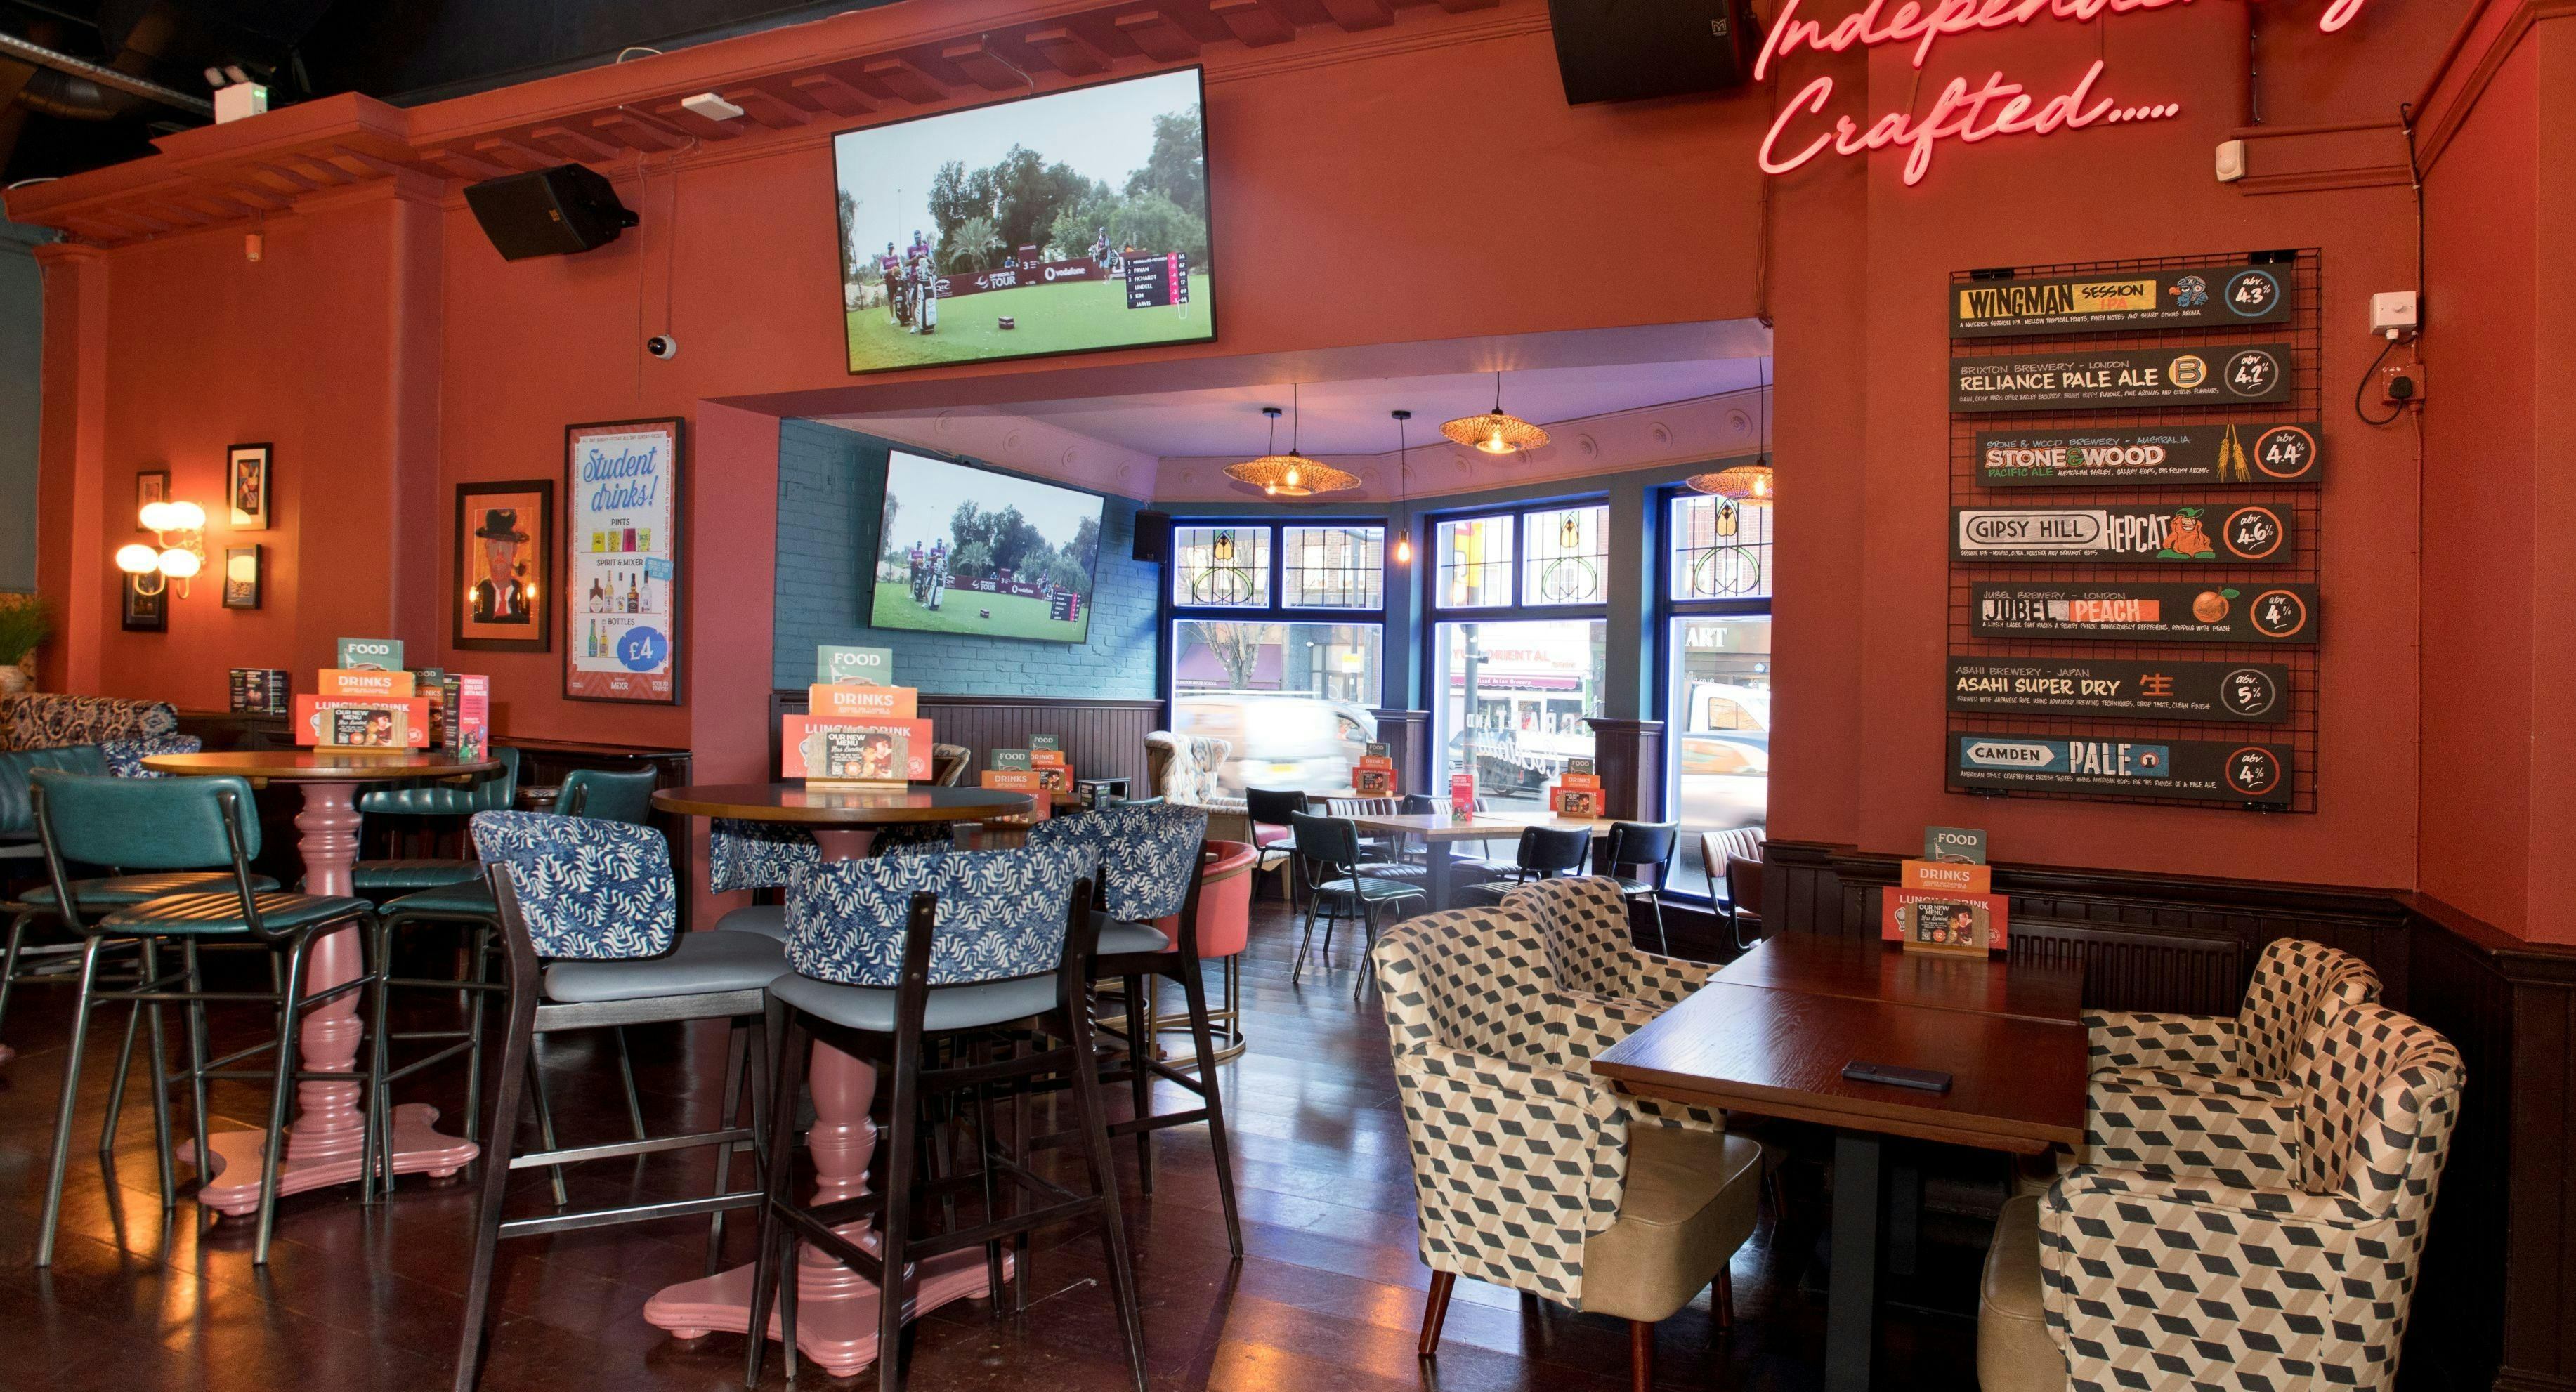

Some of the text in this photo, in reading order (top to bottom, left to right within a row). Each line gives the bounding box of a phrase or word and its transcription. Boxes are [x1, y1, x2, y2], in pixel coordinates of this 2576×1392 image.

[1023, 261, 1028, 270] 3
[1055, 267, 1086, 276] vodafone
[990, 276, 1016, 289] TOUR
[2081, 284, 2143, 299] SESSION
[1968, 283, 2074, 317] WINGMAN
[2100, 297, 2128, 310] IPA
[1961, 360, 2129, 375] BRIXTON BREWERY LONDON
[1960, 368, 2159, 391] RELIANCE PALE ALE
[2032, 439, 2062, 447] WOOD
[2069, 438, 2120, 446] BREWERY
[2136, 435, 2192, 445] AUSTRALIA
[584, 446, 658, 483] Student
[1989, 468, 2054, 477] PACIFIC ALE
[591, 475, 659, 511] drinks!
[1976, 520, 2084, 538] GIPSY HILL
[2105, 514, 2171, 553] HEPCAT
[1984, 591, 2012, 599] JUBEL
[1985, 599, 2057, 622] JUBEL
[2075, 599, 2140, 622] PEACH
[2266, 605, 2291, 624] 4%
[348, 643, 389, 655] FOOD
[629, 636, 653, 661] £4
[1488, 649, 1550, 662] ORIENTAL
[834, 652, 881, 666] FOOD
[1989, 667, 2041, 676] BREWERY
[2057, 669, 2090, 677] JAPAN
[339, 676, 392, 687] DRINKS
[1956, 677, 2120, 696] ASAHI SUPER DRY
[2139, 673, 2174, 697] 生
[834, 692, 894, 706] DRINKS
[2238, 686, 2261, 704] 5%
[1975, 741, 2131, 776] CAMDEN PALE
[2240, 766, 2264, 783] 4%
[1938, 833, 1977, 846] FOOD
[1919, 868, 1970, 881] DRINKS
